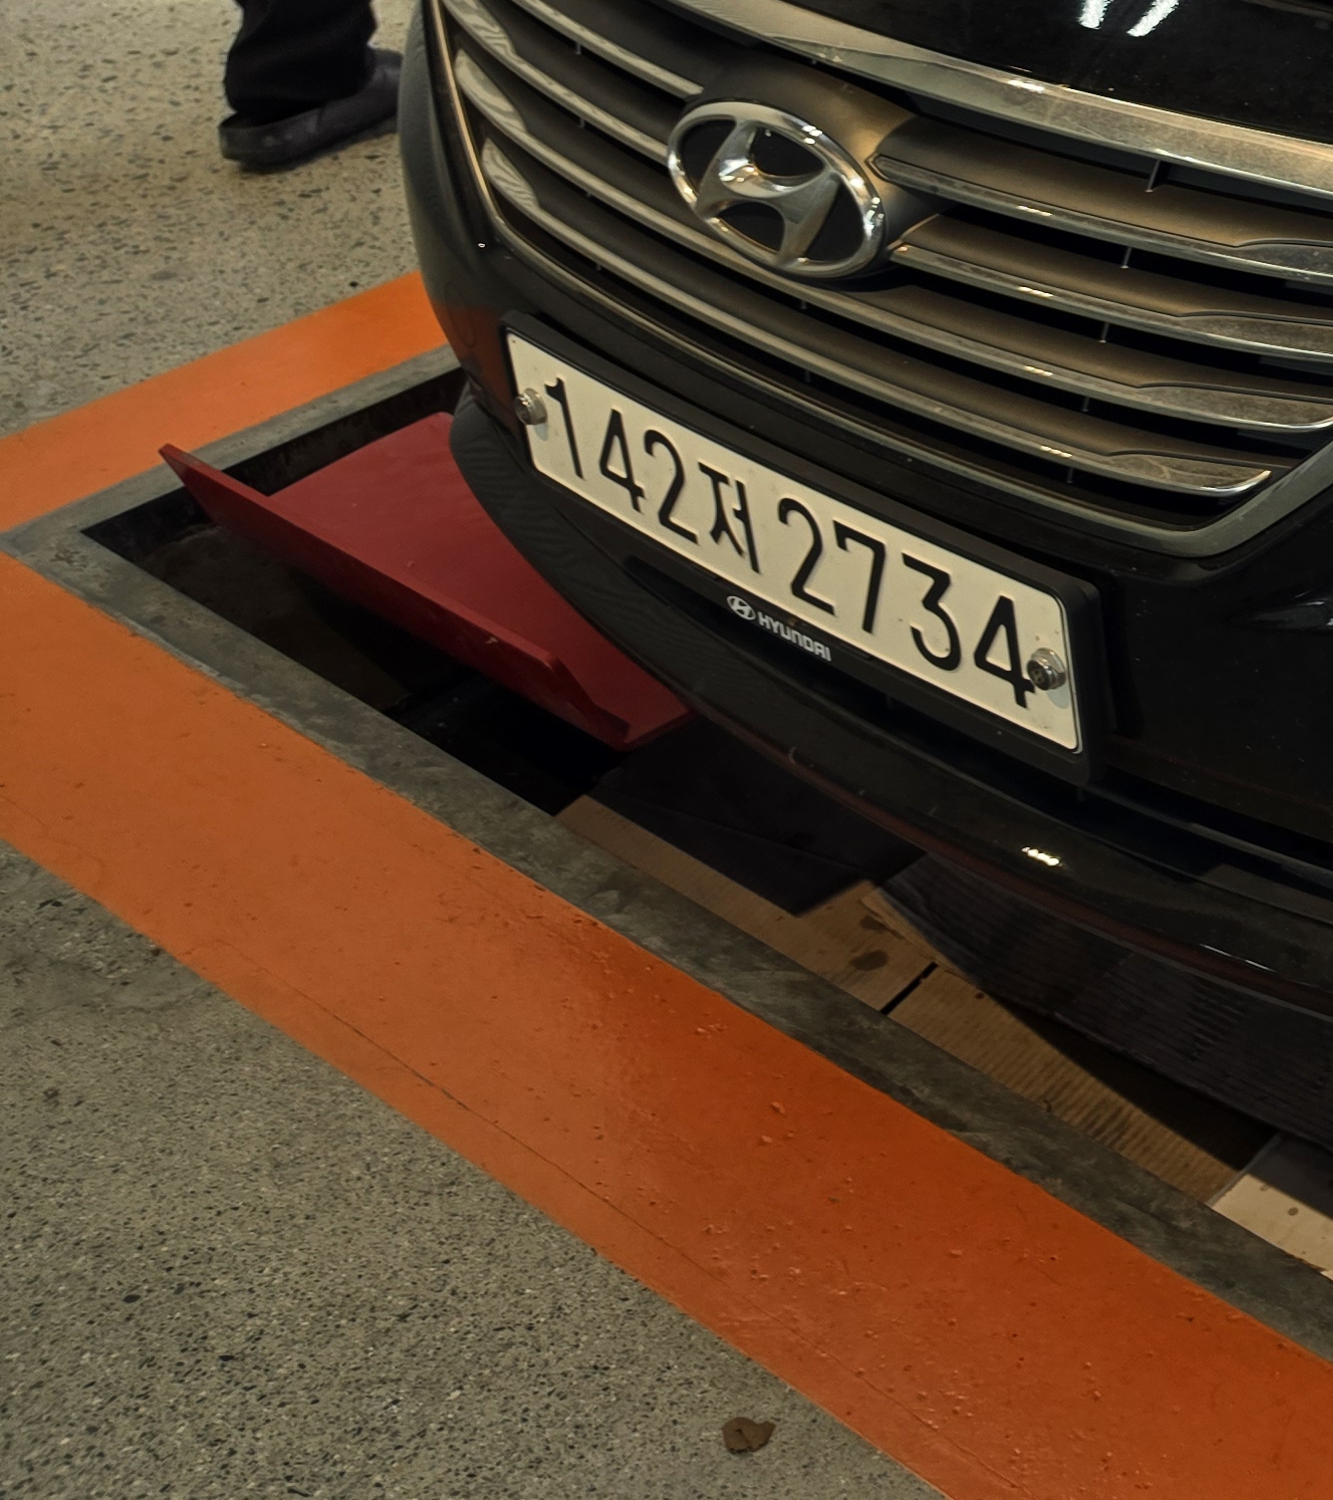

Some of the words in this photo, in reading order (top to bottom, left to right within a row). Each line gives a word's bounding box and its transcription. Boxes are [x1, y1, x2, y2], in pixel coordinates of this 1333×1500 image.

[544, 376, 761, 574] 142저
[778, 497, 1036, 709] 2734
[757, 611, 832, 662] HYUNDAI
